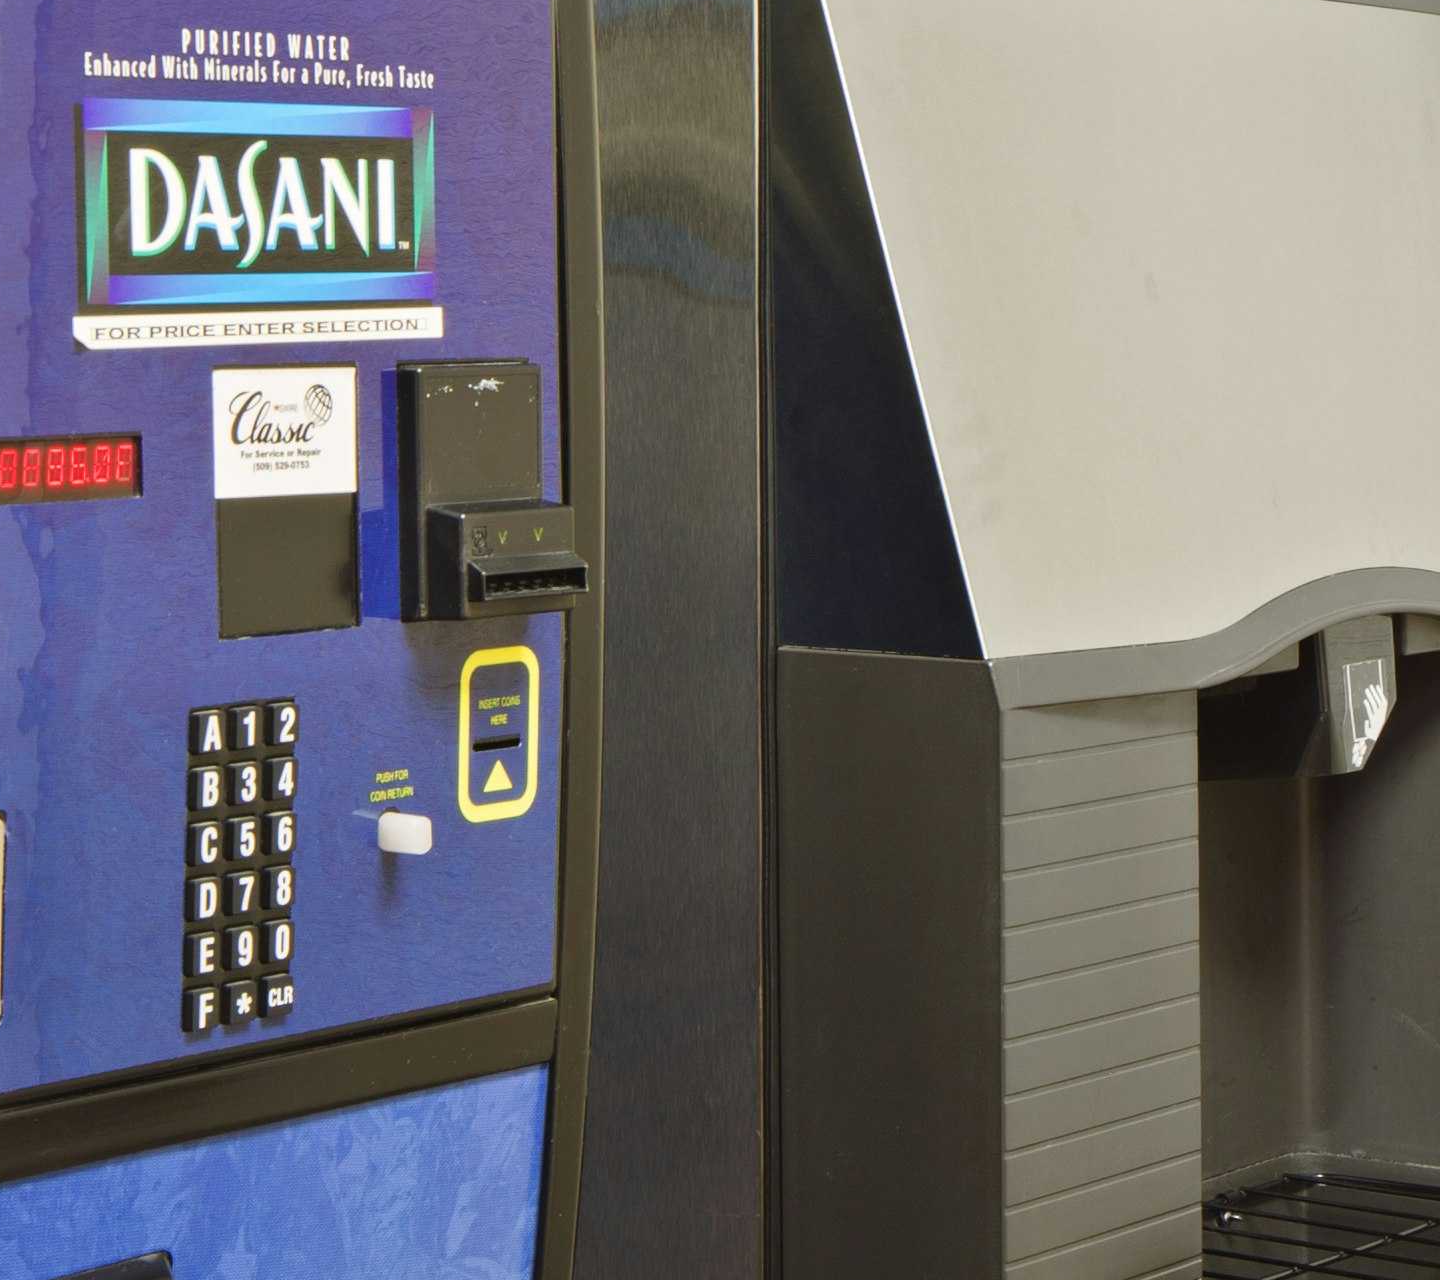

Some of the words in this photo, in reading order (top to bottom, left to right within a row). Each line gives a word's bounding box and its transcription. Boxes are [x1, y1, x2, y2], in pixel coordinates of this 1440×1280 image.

[181, 28, 276, 59] PURIFIED
[288, 34, 350, 61] WATER
[84, 52, 156, 79] Enhanced
[162, 55, 198, 80] With
[204, 57, 268, 84] Minerals
[273, 61, 295, 84] For
[301, 68, 309, 85] a
[314, 62, 351, 90] Pure,
[356, 64, 393, 88] Fresh
[398, 66, 434, 90] Taste
[129, 139, 396, 269] DASANI
[95, 327, 141, 341] FOR
[149, 324, 215, 339] PRICE
[224, 321, 295, 336] ENTER
[302, 318, 418, 335] SELECTION
[229, 391, 315, 445] Classic
[256, 450, 283, 458] Service
[297, 448, 321, 457] Repair
[203, 715, 221, 751] A
[244, 711, 255, 746] 1
[280, 707, 295, 743] 2
[202, 772, 218, 808] B
[242, 767, 256, 802] 3
[278, 762, 293, 797] 4
[201, 828, 217, 864] C
[240, 822, 255, 857] 5
[277, 816, 292, 852] 6
[200, 882, 216, 918] D
[239, 877, 254, 911] 7
[276, 870, 291, 906] 8
[200, 937, 215, 973] E
[238, 931, 253, 967] 9
[275, 924, 290, 960] 0
[199, 993, 213, 1029] F
[268, 985, 293, 1008] CLR
